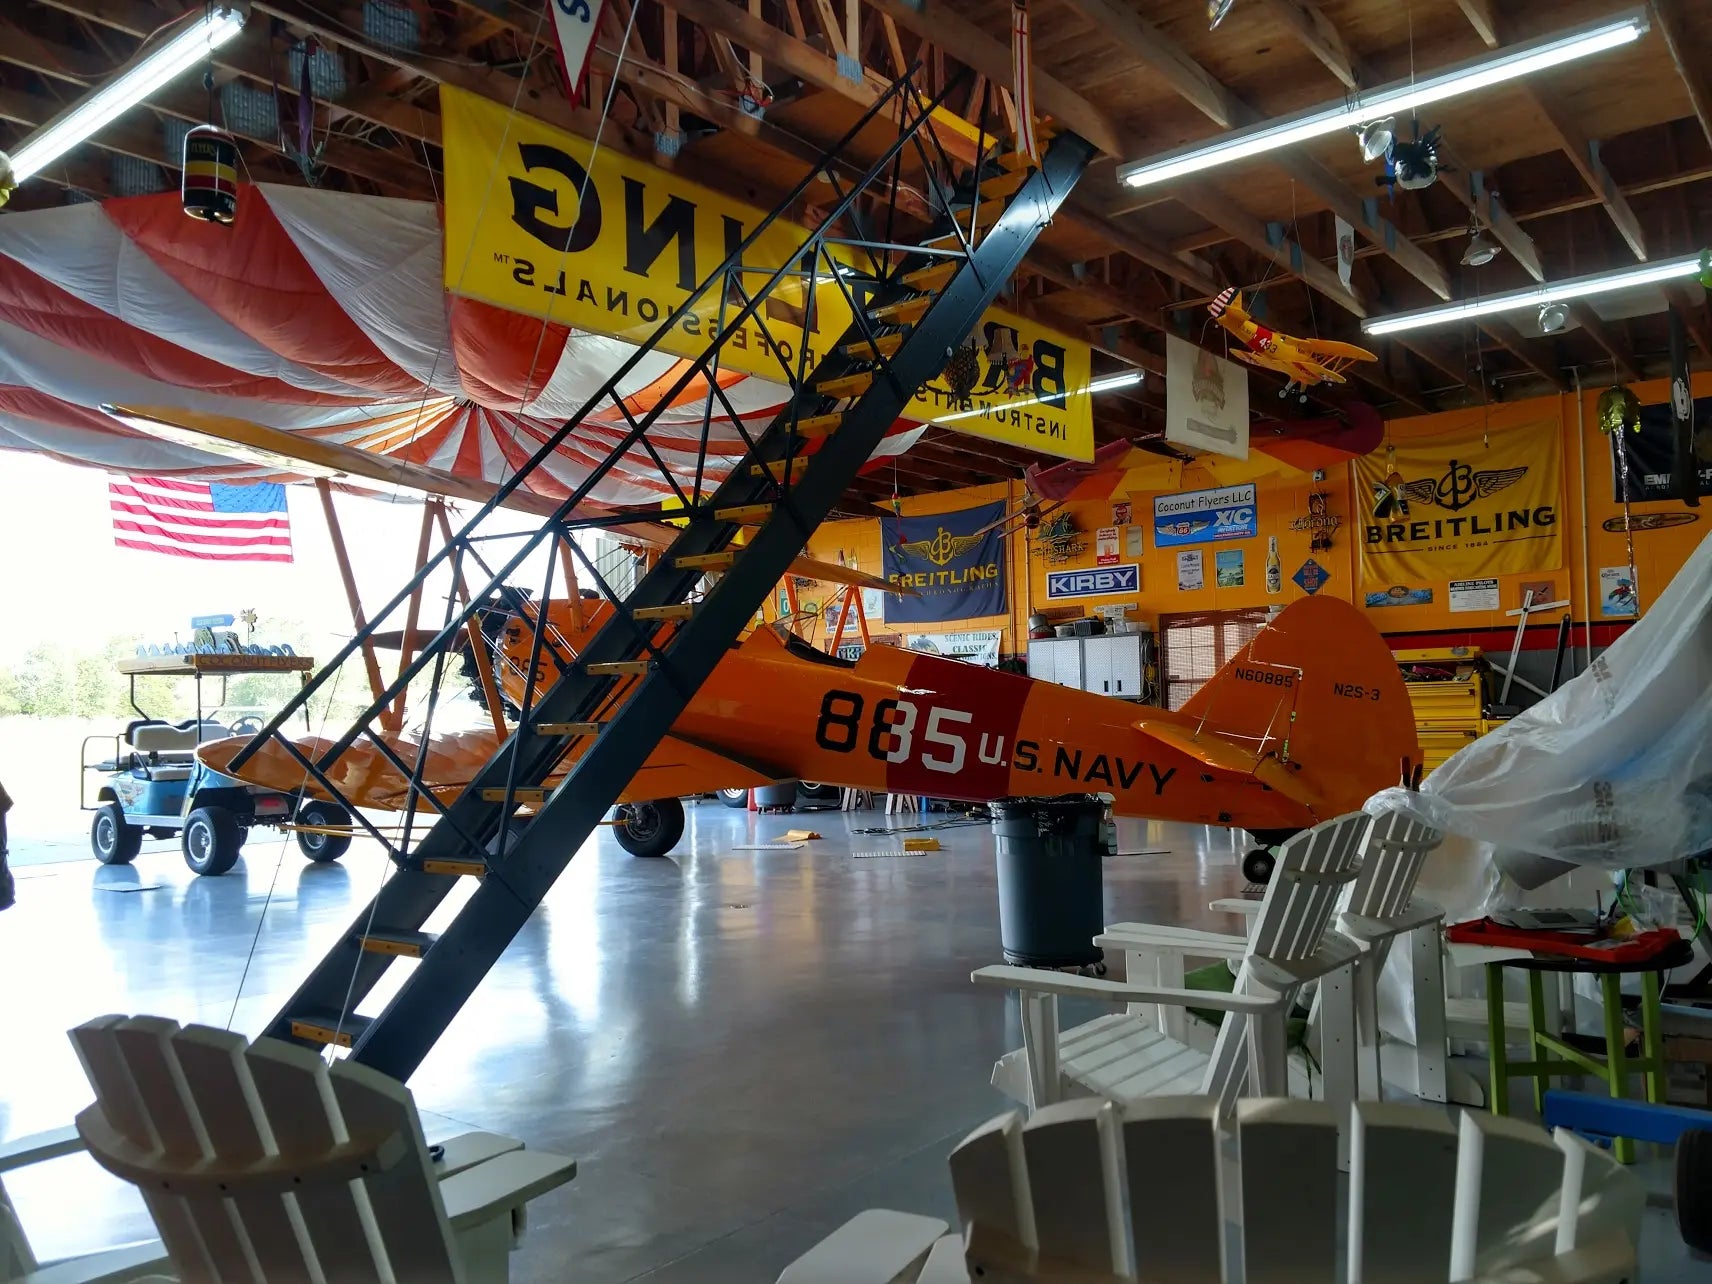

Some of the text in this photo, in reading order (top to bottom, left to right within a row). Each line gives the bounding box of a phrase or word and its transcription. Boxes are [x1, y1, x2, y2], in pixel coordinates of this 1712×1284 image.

[1157, 490, 1251, 513] Coconut Flyers LLC
[1365, 506, 1556, 544] BREITLING
[1427, 544, 1458, 552] SINCE
[1051, 571, 1134, 593] KIRBY
[944, 633, 971, 643] SCENIC
[199, 656, 269, 667] COCONUT
[1235, 667, 1294, 688] N60885
[1333, 682, 1381, 701] N2S-3
[815, 689, 973, 775] 885
[978, 732, 1177, 796] U.S. NAVY
